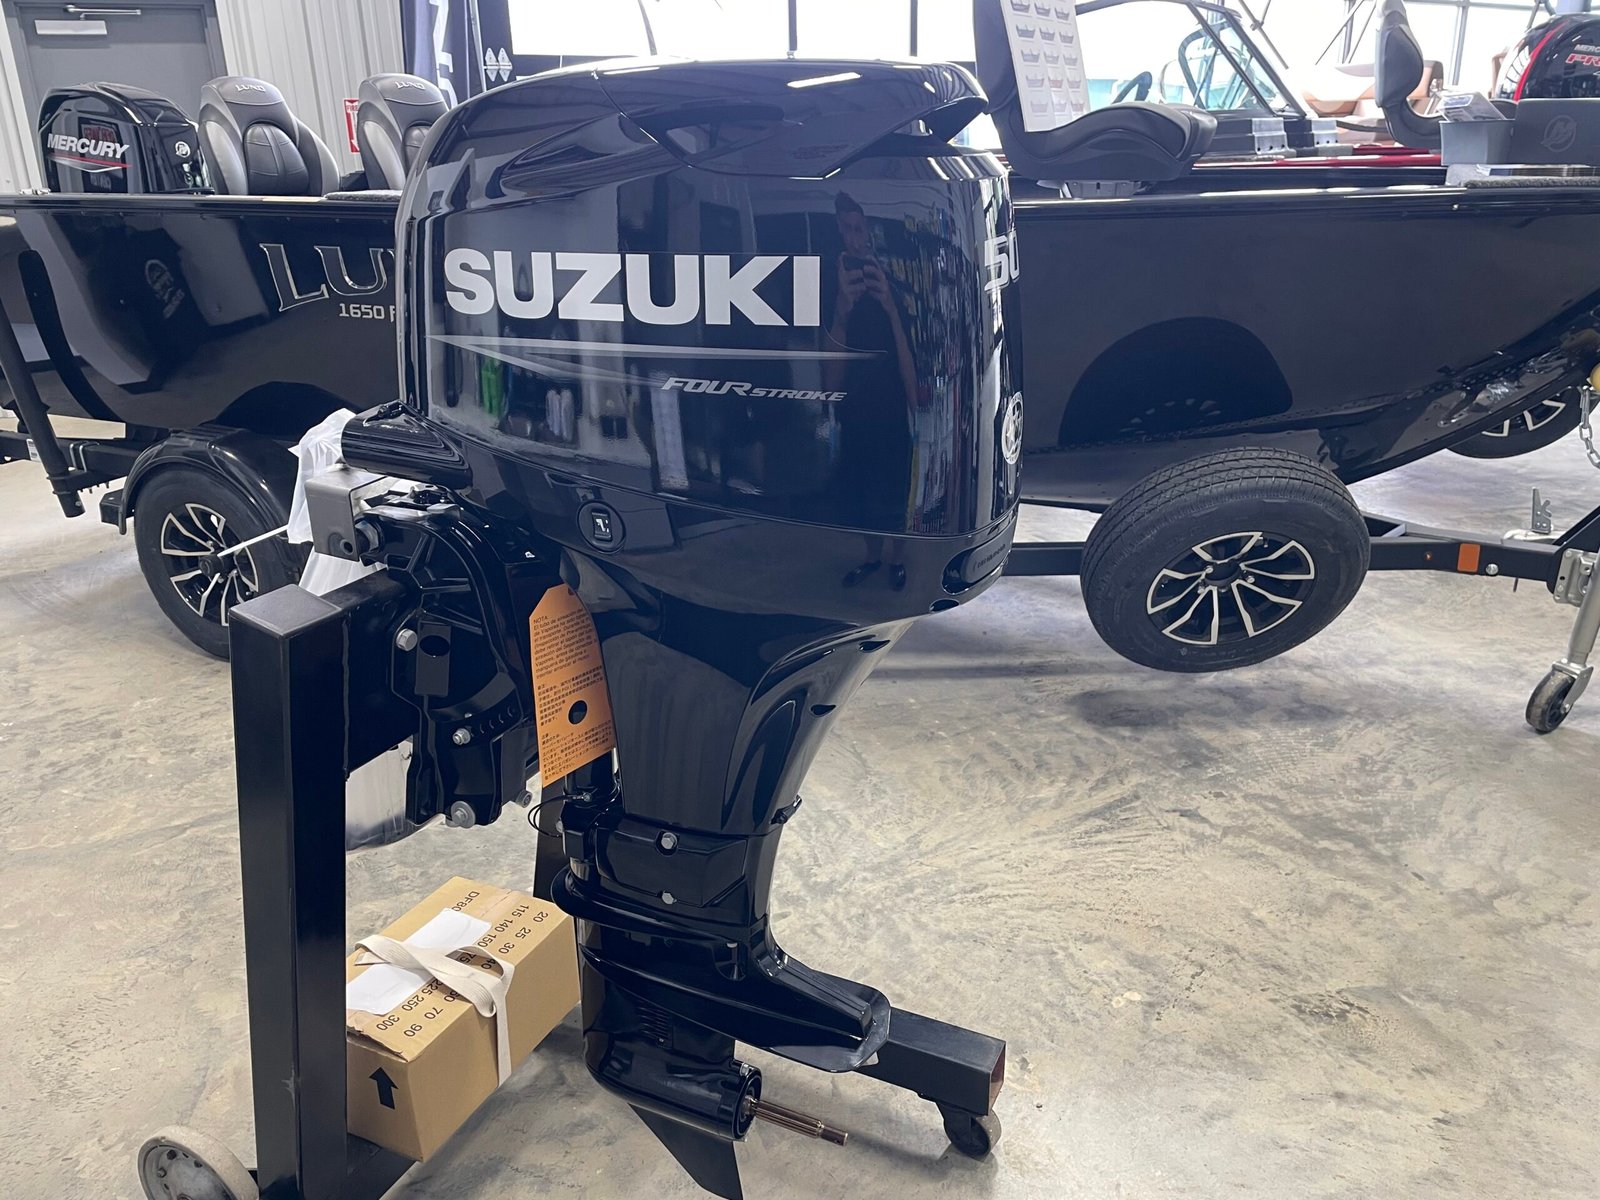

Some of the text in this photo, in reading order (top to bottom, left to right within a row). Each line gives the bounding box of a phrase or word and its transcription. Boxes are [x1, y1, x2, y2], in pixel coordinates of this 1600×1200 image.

[47, 133, 130, 159] MERCURY
[984, 230, 1020, 293] 50
[443, 247, 821, 327] SUZUKI
[339, 303, 385, 319] 1650
[661, 377, 848, 402] FOUR STROKE
[452, 890, 480, 912] DF80
[511, 904, 530, 918] 115
[532, 911, 549, 922] 20
[494, 918, 514, 932] 140
[515, 926, 532, 939] 25
[478, 933, 496, 948] 150
[498, 942, 515, 954] 30
[480, 958, 496, 970] 40
[421, 978, 443, 996] 225
[401, 994, 424, 1012] 250
[424, 1006, 444, 1020] 70
[376, 1014, 400, 1031] 300
[403, 1023, 422, 1037] 90
